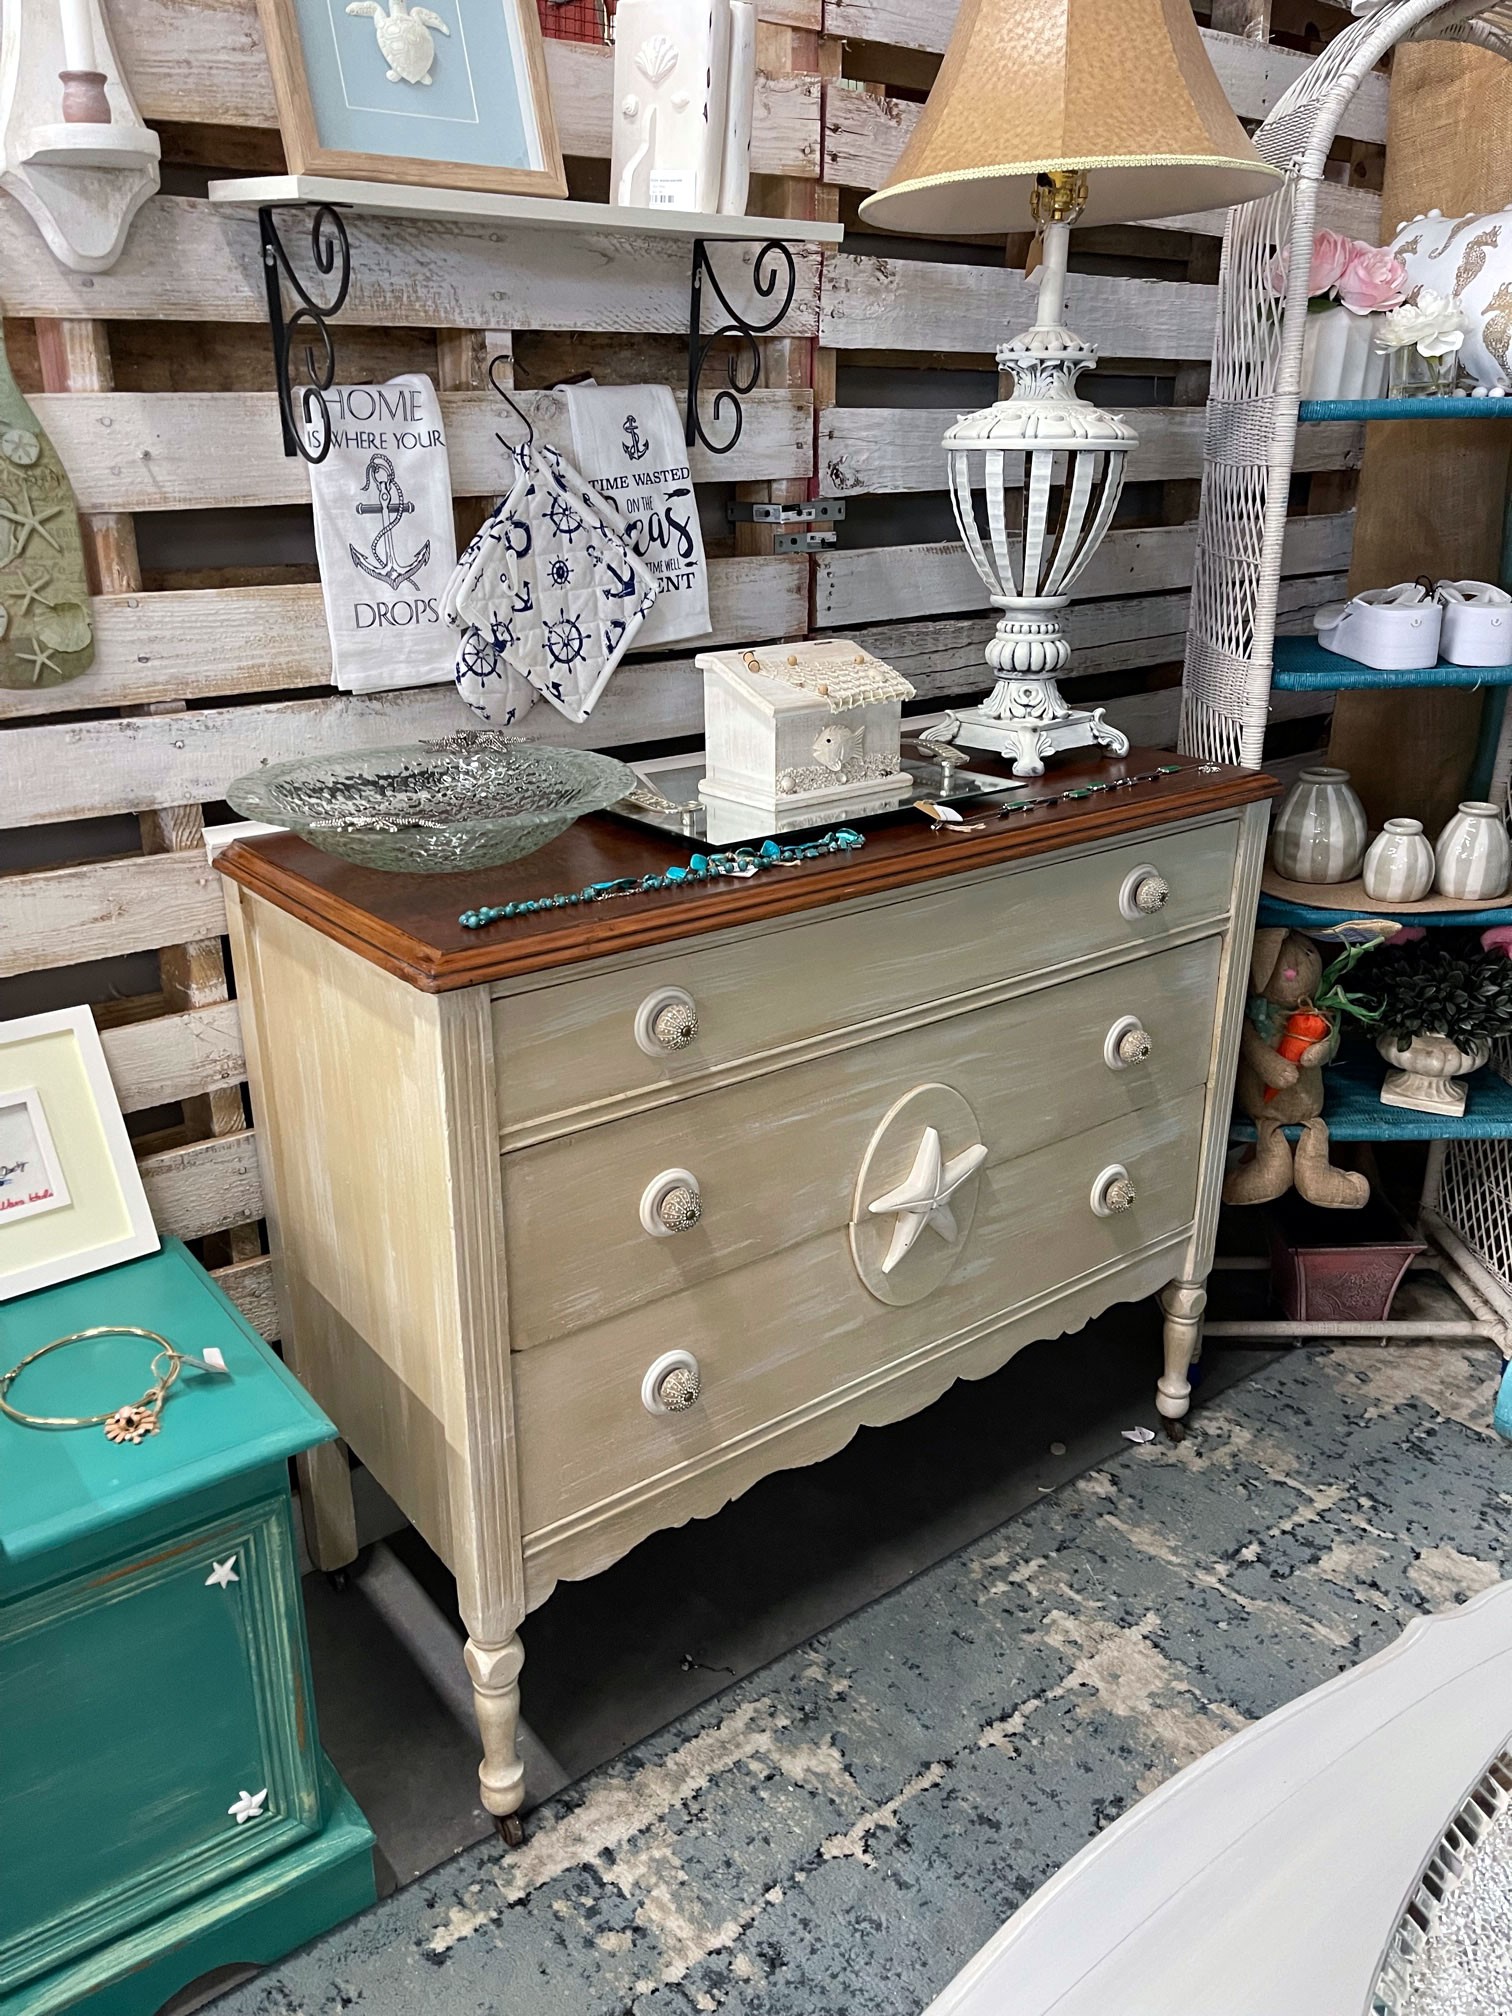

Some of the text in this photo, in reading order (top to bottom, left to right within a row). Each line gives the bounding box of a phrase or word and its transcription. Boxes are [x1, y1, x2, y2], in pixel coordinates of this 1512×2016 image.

[322, 388, 424, 422] HOME
[307, 430, 446, 450] IS WHERE YOUR
[588, 467, 690, 492] TIME WASTED
[626, 495, 654, 514] ON THE
[664, 557, 681, 572] WELL
[657, 572, 696, 594] ENT
[353, 597, 440, 629] DROPS
